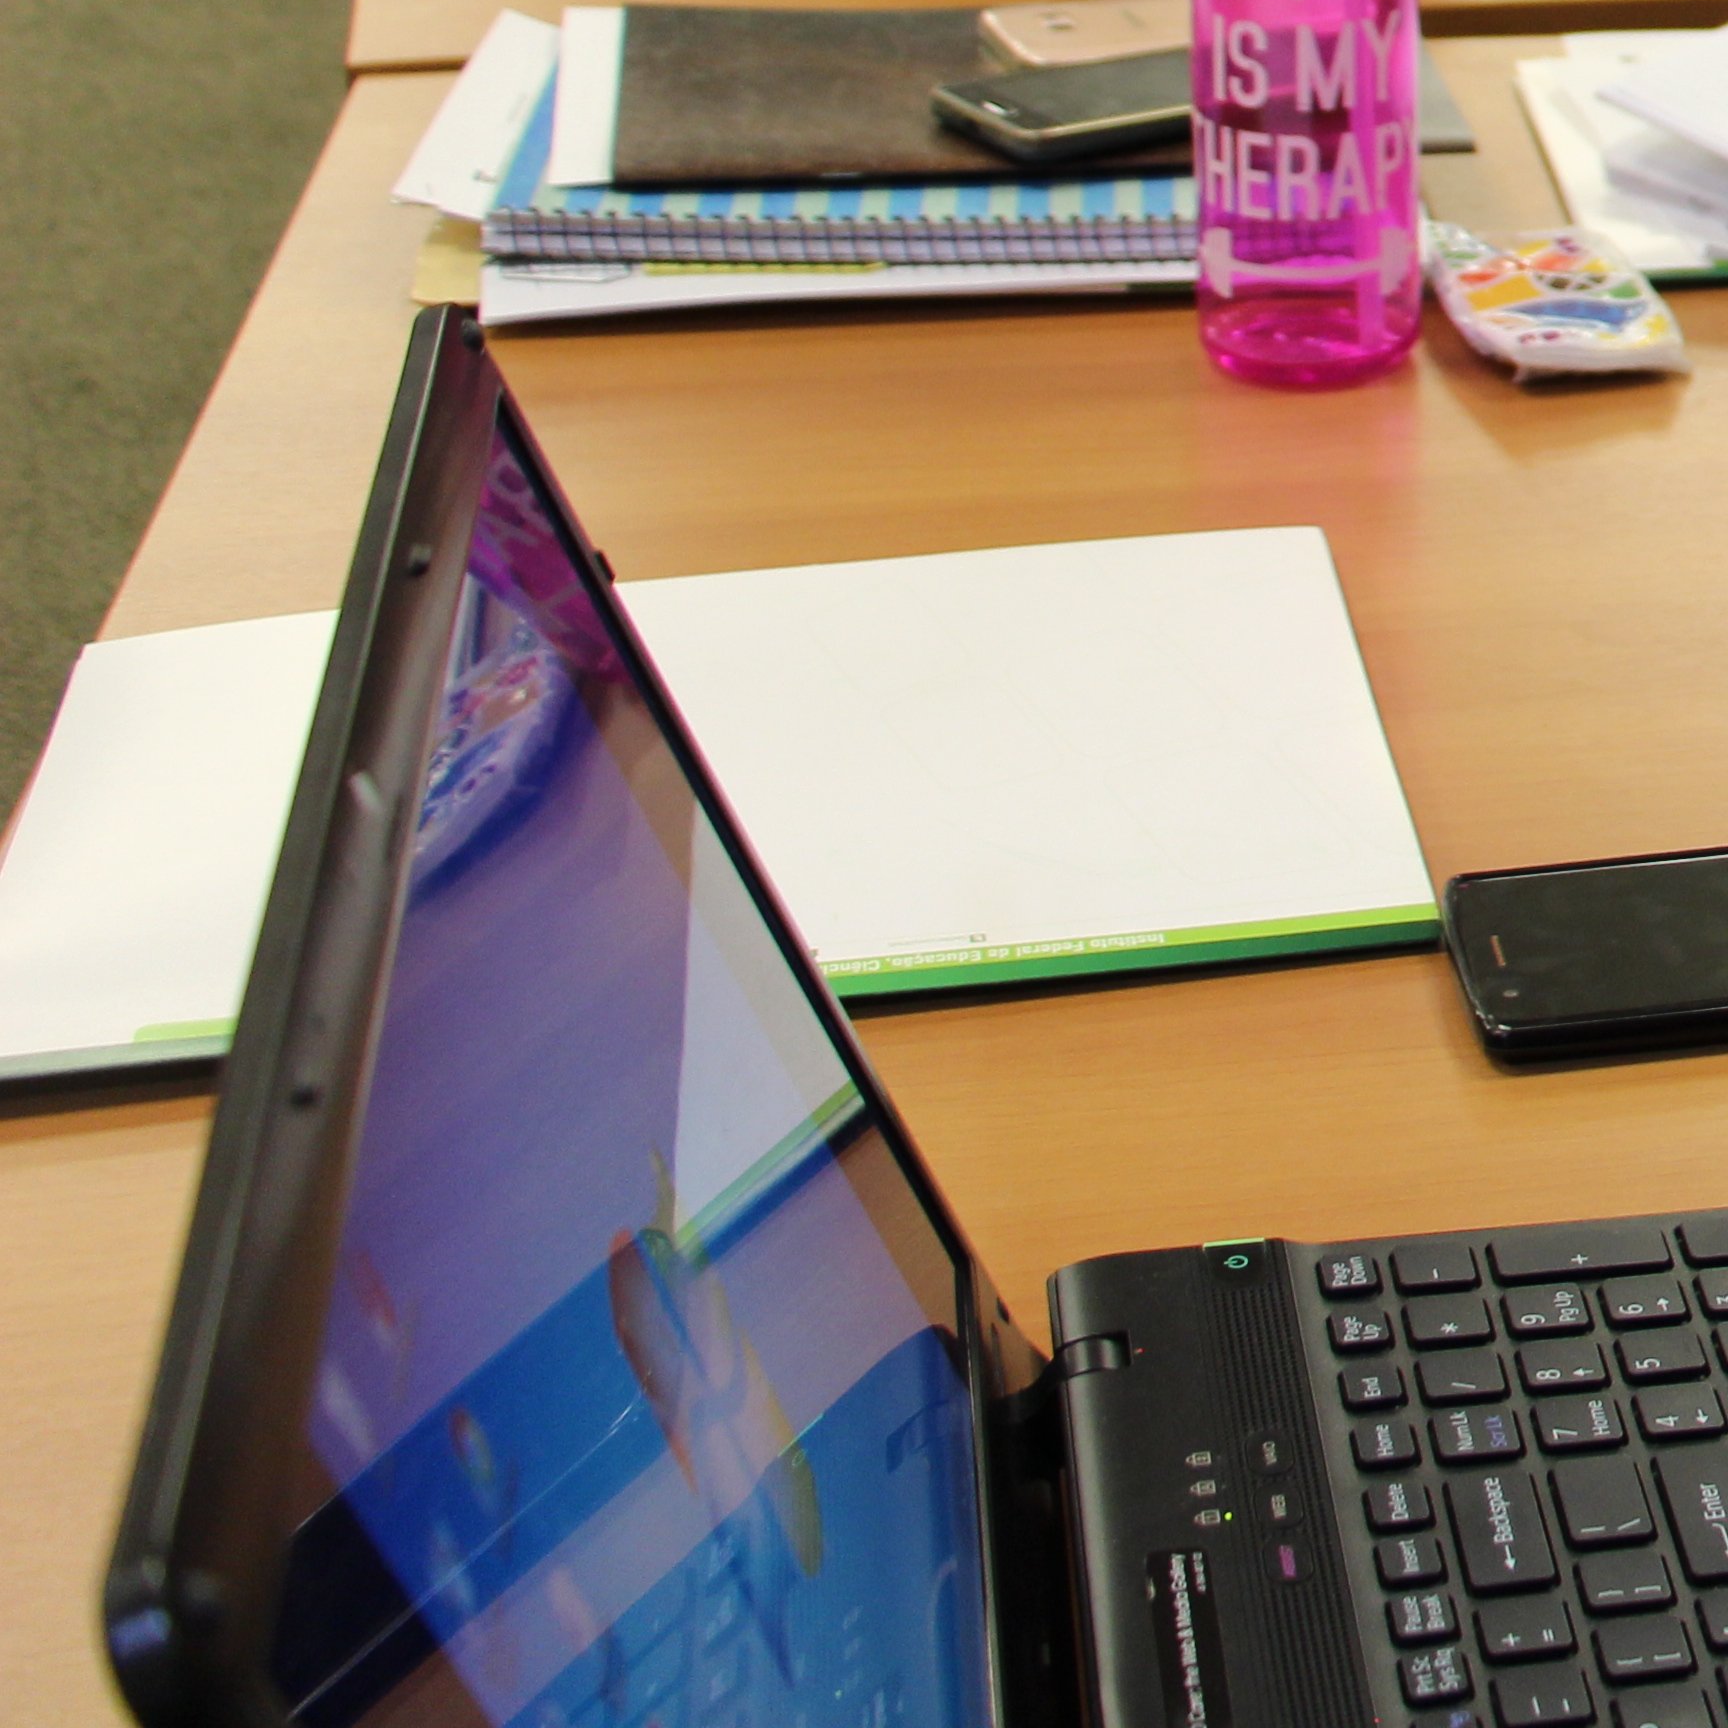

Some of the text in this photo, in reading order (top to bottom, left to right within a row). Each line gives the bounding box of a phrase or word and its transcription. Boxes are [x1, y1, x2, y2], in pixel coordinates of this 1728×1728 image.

[1212, 9, 1401, 111] IS MY
[819, 931, 1167, 975] Instituto Federal de Educação, Ciênci
[1332, 1261, 1351, 1287] Page
[1350, 1255, 1368, 1285] Down
[1520, 1313, 1546, 1325] 9
[1553, 1290, 1580, 1322] Pg Up
[1618, 1303, 1645, 1315] 6
[1343, 1316, 1363, 1342] Page
[1363, 1322, 1382, 1341] Up
[1535, 1368, 1562, 1380] 8
[1635, 1357, 1661, 1370] 5
[1361, 1376, 1382, 1398] End
[1588, 1399, 1611, 1437] Home
[1654, 1415, 1680, 1427] 4
[1376, 1424, 1395, 1457] Home
[1551, 1427, 1579, 1441] 7
[1387, 1483, 1410, 1522] Delete
[1483, 1476, 1515, 1544] Backspace
[1700, 1482, 1727, 1521] Enter
[1398, 1538, 1421, 1573] Insert
[1403, 1595, 1423, 1633] Pause
[1421, 1593, 1446, 1631] Break
[1411, 1655, 1435, 1695] Prt Sc
[1438, 1666, 1462, 1691] Sys
